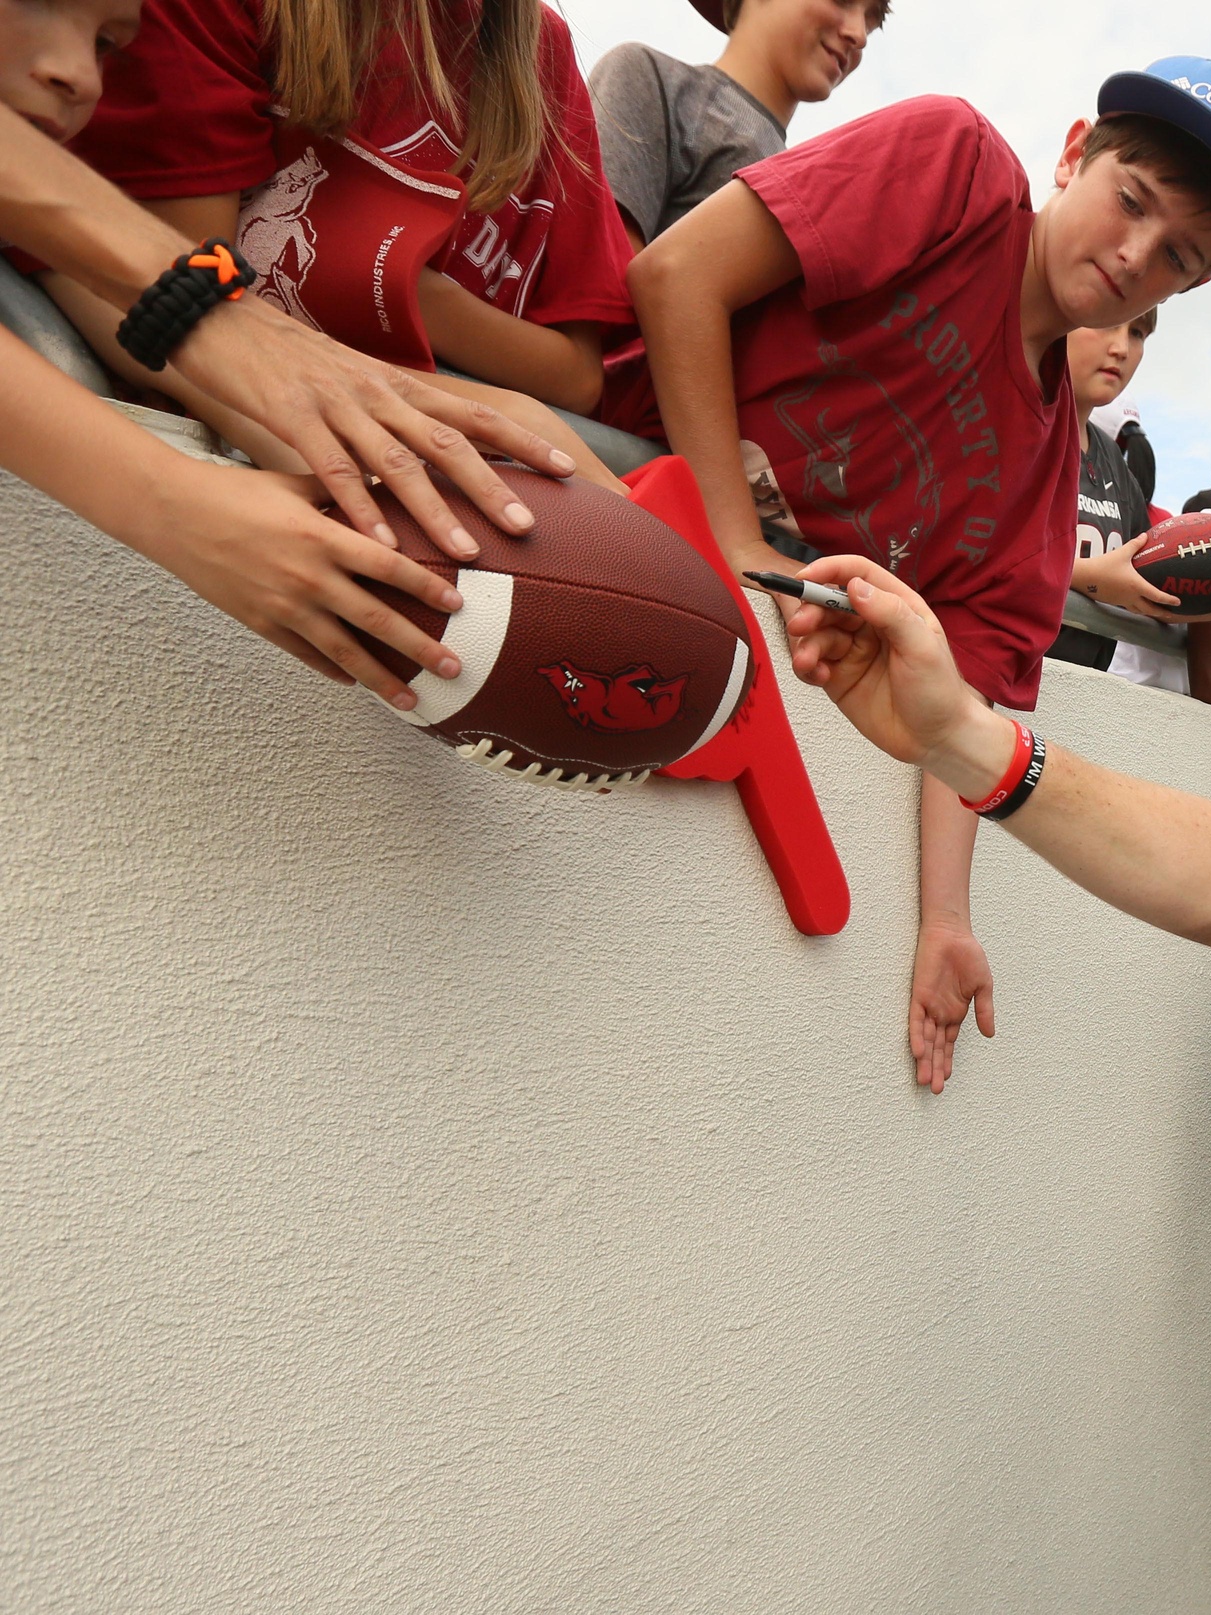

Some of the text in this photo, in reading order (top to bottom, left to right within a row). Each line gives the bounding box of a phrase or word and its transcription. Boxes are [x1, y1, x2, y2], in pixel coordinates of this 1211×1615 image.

[373, 225, 406, 333] RICO INDUSTRIES, INC.
[879, 291, 1001, 567] PROPERTY OF
[1077, 493, 1122, 520] RKANSA
[1024, 761, 1043, 787] I'M
